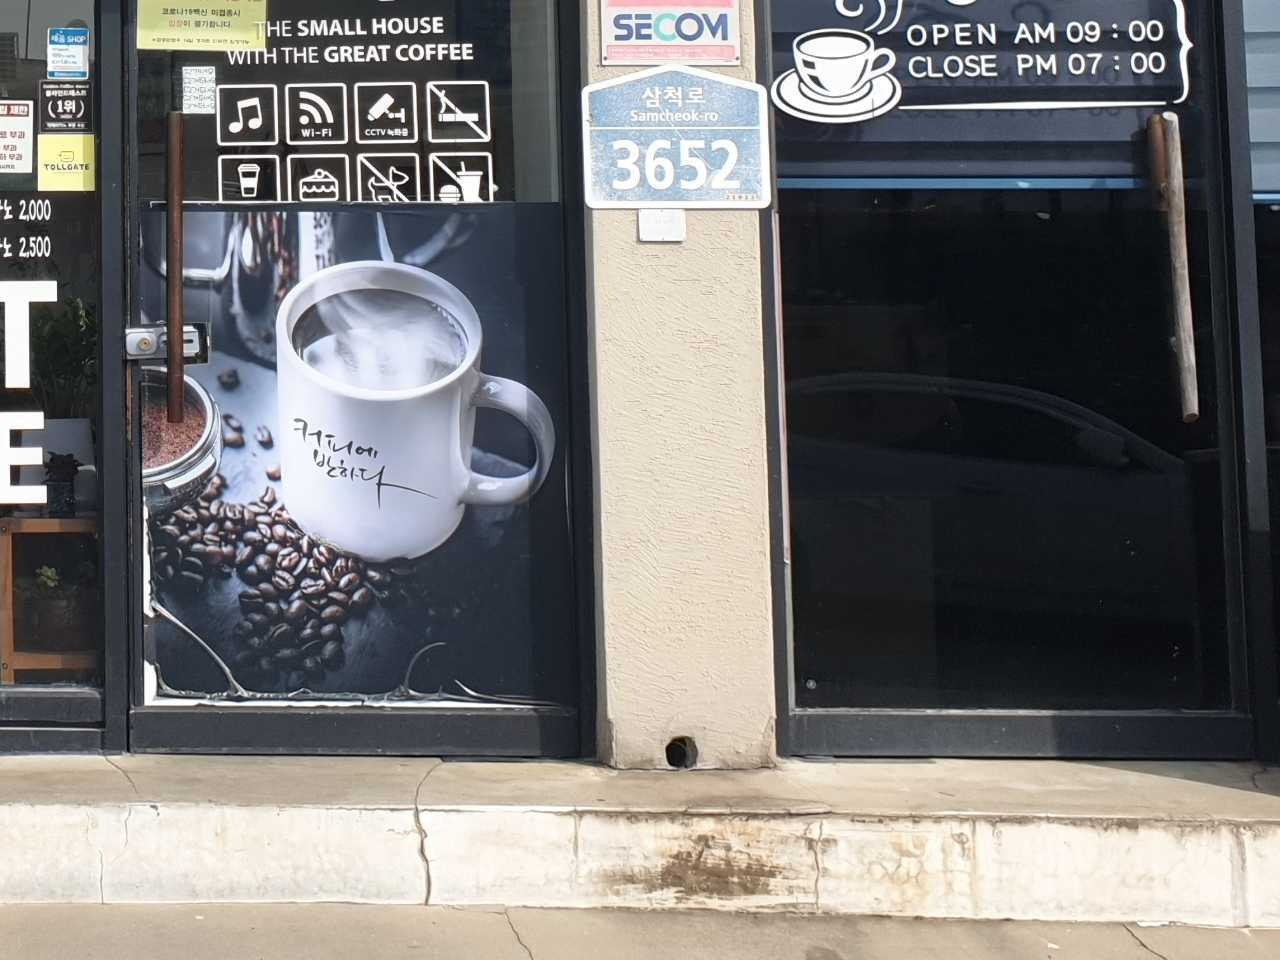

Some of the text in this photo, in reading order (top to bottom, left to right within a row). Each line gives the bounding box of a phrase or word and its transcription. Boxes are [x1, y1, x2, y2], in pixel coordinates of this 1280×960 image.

[297, 18, 367, 37] SMALL
[372, 16, 445, 35] HOUSE
[613, 12, 729, 42] SECOM
[906, 23, 997, 47] OPEN
[1014, 22, 1056, 45] AM
[227, 42, 474, 65] WITH THE GREAT COFFEE
[908, 55, 998, 79] CLOSE
[1017, 55, 1057, 76] PM
[56, 99, 76, 113] 1위
[641, 86, 706, 108] 삼척로
[630, 109, 719, 123] Samcheok-ro
[300, 128, 333, 138] Wi-Fi
[43, 163, 90, 171] TOLLGATE
[611, 139, 741, 190] 3652
[19, 199, 52, 222] 2,000
[19, 236, 51, 258] 2,500
[294, 417, 378, 459] 커피에
